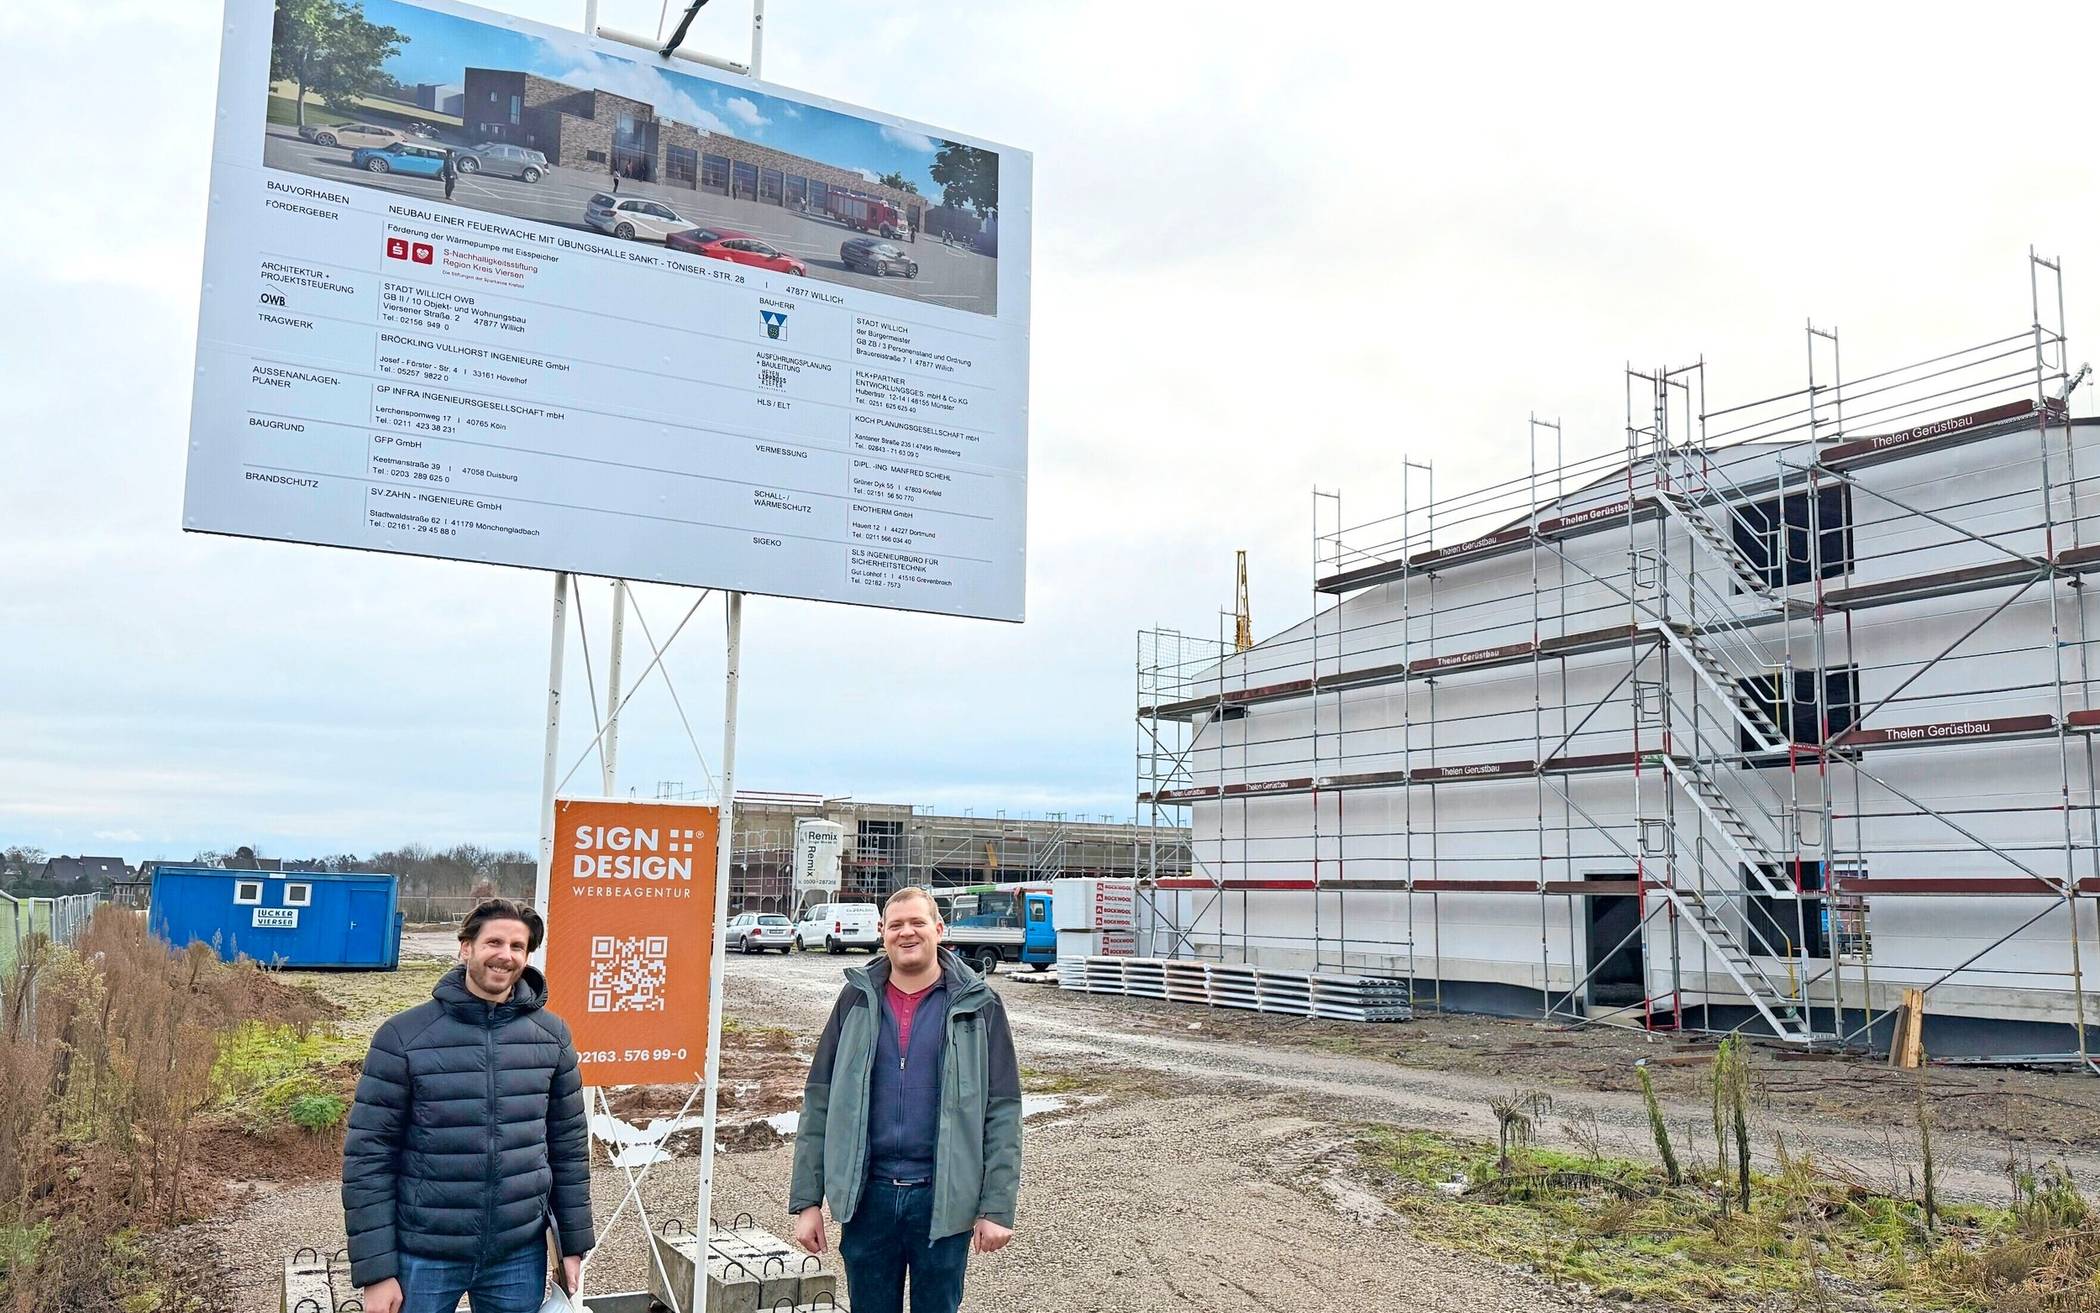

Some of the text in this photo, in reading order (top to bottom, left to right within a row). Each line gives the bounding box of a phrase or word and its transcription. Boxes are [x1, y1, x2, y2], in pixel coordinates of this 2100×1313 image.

[267, 181, 350, 205] BAUVORHABEN
[388, 205, 432, 221] NEUBAU
[434, 214, 465, 228] EINER
[467, 220, 536, 242] FEUERWACHE
[538, 235, 555, 244] MIT
[628, 253, 659, 266] SANKT
[713, 270, 732, 282] STR.
[786, 286, 809, 297] 47877
[810, 291, 844, 305] WILLICH
[515, 248, 559, 263] Eisspeicher
[261, 262, 323, 279] ARCHITEKTUR
[442, 258, 471, 270] Region
[472, 264, 493, 274] Kreis
[494, 268, 524, 280] Viersen
[260, 271, 354, 294] PROJEKTSTEUERUNG
[260, 293, 286, 306] OWB
[384, 283, 475, 306] STADT WILLICH OWB
[759, 297, 795, 311] BAUHERR
[258, 313, 313, 330] TRAGWERK
[436, 343, 488, 358] VULLHORST
[490, 352, 544, 368] INGENIEURE
[545, 362, 570, 372] GmbH
[252, 366, 340, 386] AUSSENANLAGEN-
[252, 376, 291, 388] PLANER
[392, 388, 420, 398] INFRA
[546, 412, 564, 420] mbH
[757, 398, 772, 407] HLS
[249, 418, 305, 433] BAUGRUND
[1871, 416, 1973, 448] Thelen Gerüstbau
[395, 438, 422, 449] GmbH
[755, 445, 808, 459] VERMESSUNG
[245, 472, 319, 488] BRANDSCHUTZ
[418, 494, 474, 508] INGENIEURE
[476, 501, 502, 511] GmbH
[1560, 502, 1634, 527] Thelen Gerüstba
[753, 537, 782, 547] SIGEKO
[1438, 656, 1460, 665] Thelen
[1885, 722, 1990, 740] Thelen Gerüstbau
[574, 826, 659, 851] SIGN
[808, 831, 838, 840] Remix
[574, 854, 692, 880] DESIGN
[807, 846, 816, 877] Remix
[572, 886, 690, 898] WERBEAGENTUR
[652, 1048, 687, 1060] 99-0
